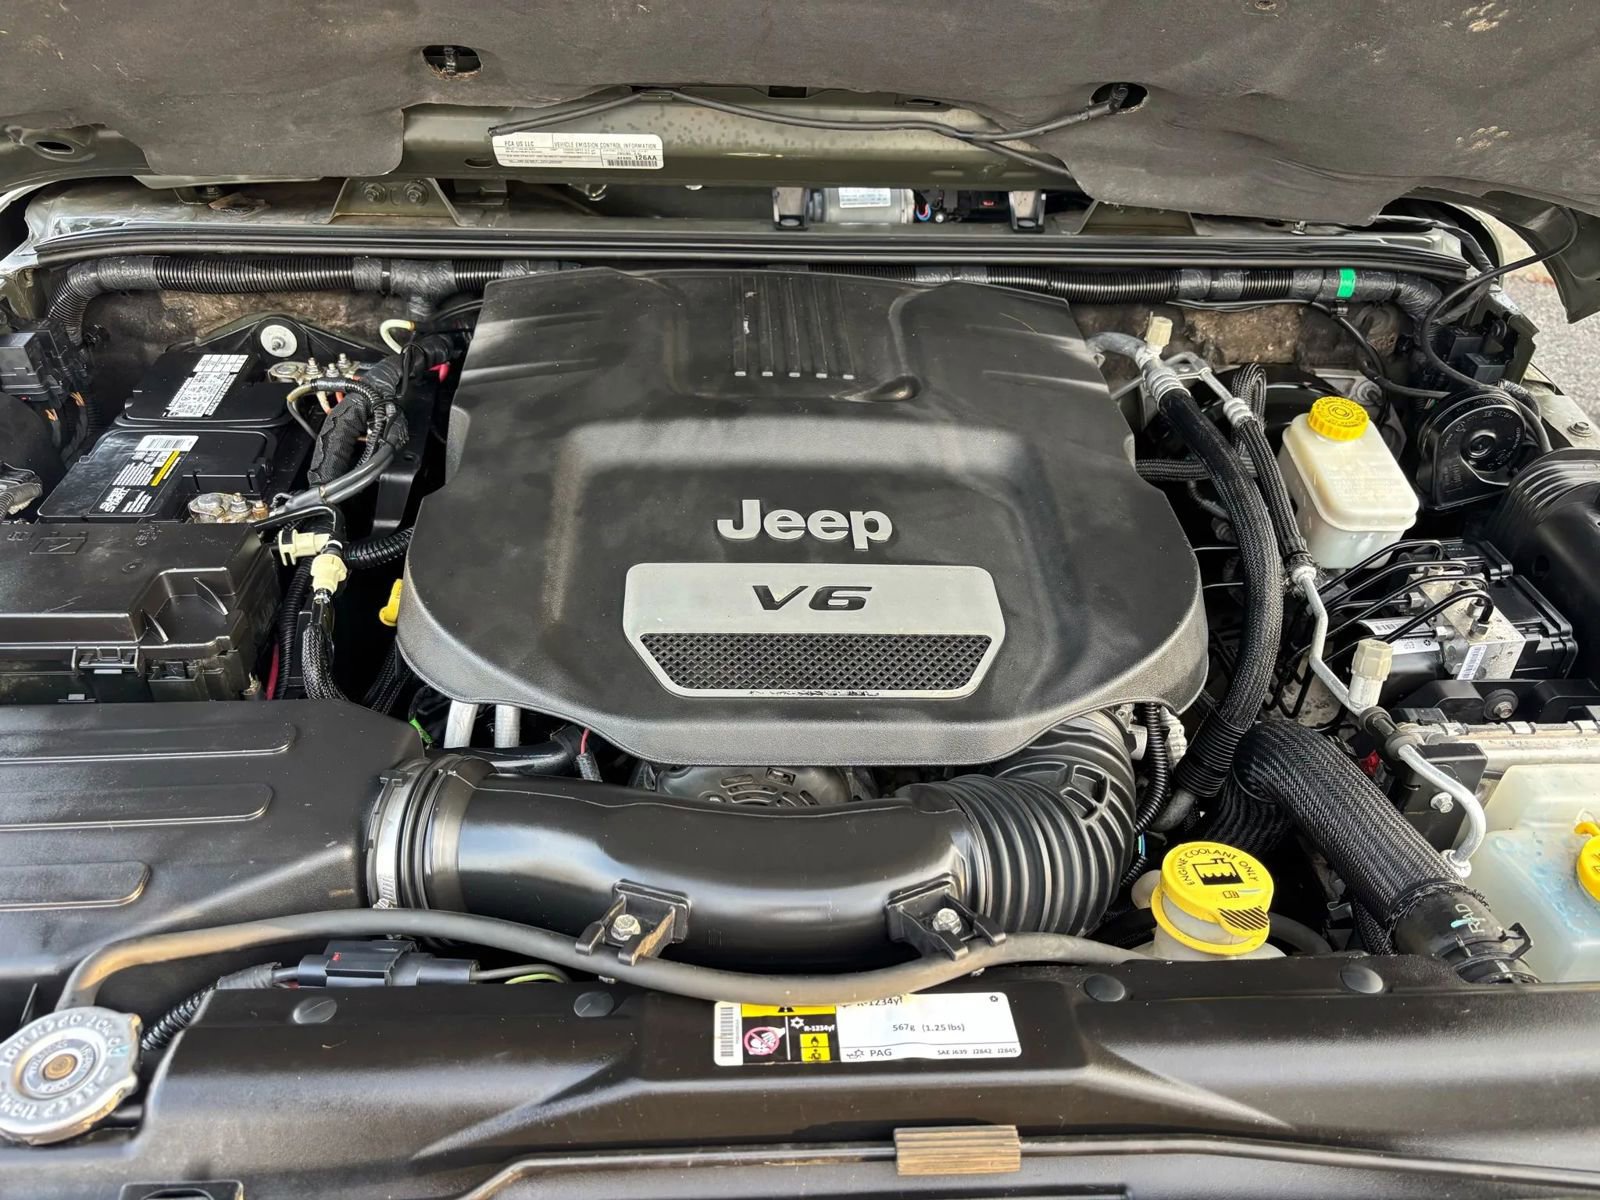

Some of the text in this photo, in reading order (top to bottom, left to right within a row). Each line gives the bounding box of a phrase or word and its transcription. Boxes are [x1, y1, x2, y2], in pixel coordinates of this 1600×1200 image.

[553, 141, 574, 149] VEHICLE
[717, 499, 893, 551] Jeep
[752, 585, 873, 611] V6
[1177, 848, 1260, 887] ENGINE COOLANT ONLY
[892, 1023, 966, 1033] 567g (1.25 lbs)
[870, 1047, 892, 1057] PAG
